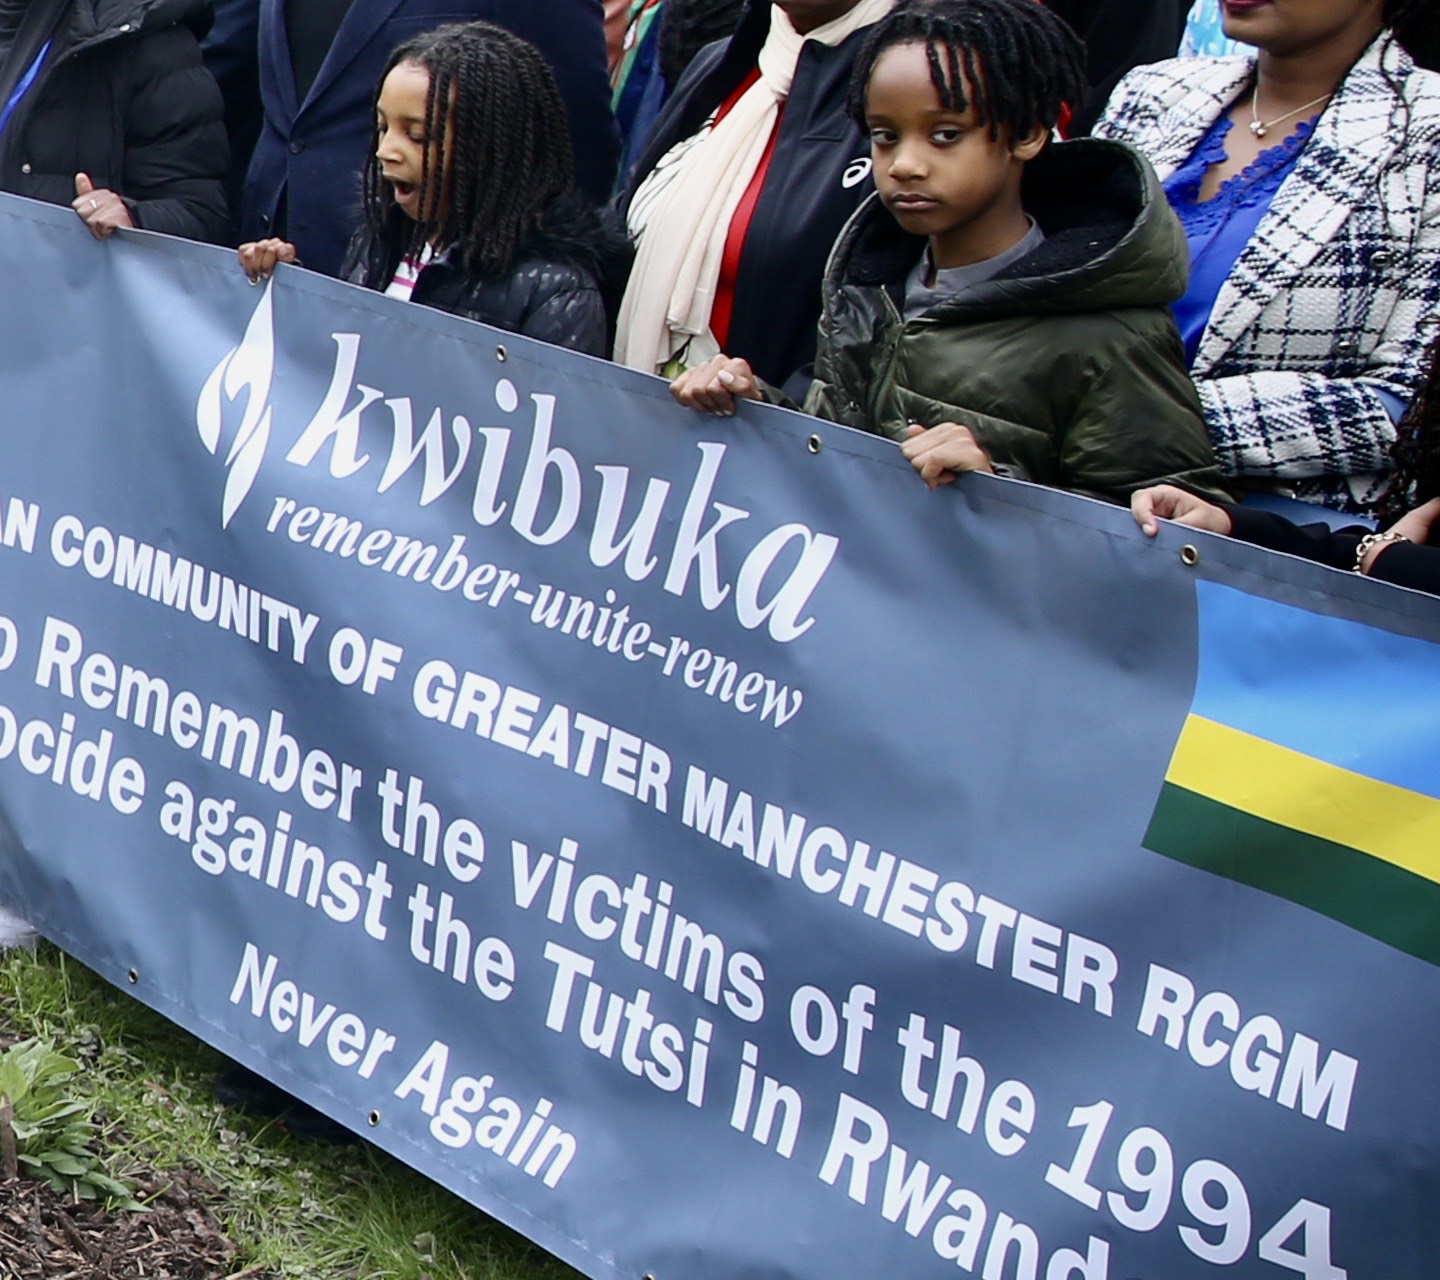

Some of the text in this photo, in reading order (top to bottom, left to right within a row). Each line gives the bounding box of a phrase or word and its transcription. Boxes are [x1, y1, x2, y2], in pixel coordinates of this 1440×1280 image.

[267, 496, 804, 729] remember-unite-renew
[285, 332, 840, 643] kwibuka
[35, 617, 363, 822] Remember
[377, 769, 486, 883] the
[510, 837, 764, 1022] victims
[789, 983, 876, 1073] of
[897, 1012, 1036, 1158] the
[51, 513, 320, 665] COMMUNITY
[327, 626, 404, 695] OF
[412, 661, 672, 813] GREATER
[681, 767, 1118, 1017] MANCHESTER
[1137, 962, 1359, 1132] RCGM
[160, 781, 393, 940] against
[408, 883, 515, 1002] the
[543, 940, 712, 1106] Tutsi
[731, 1040, 803, 1159] in
[228, 942, 579, 1189] Never Again
